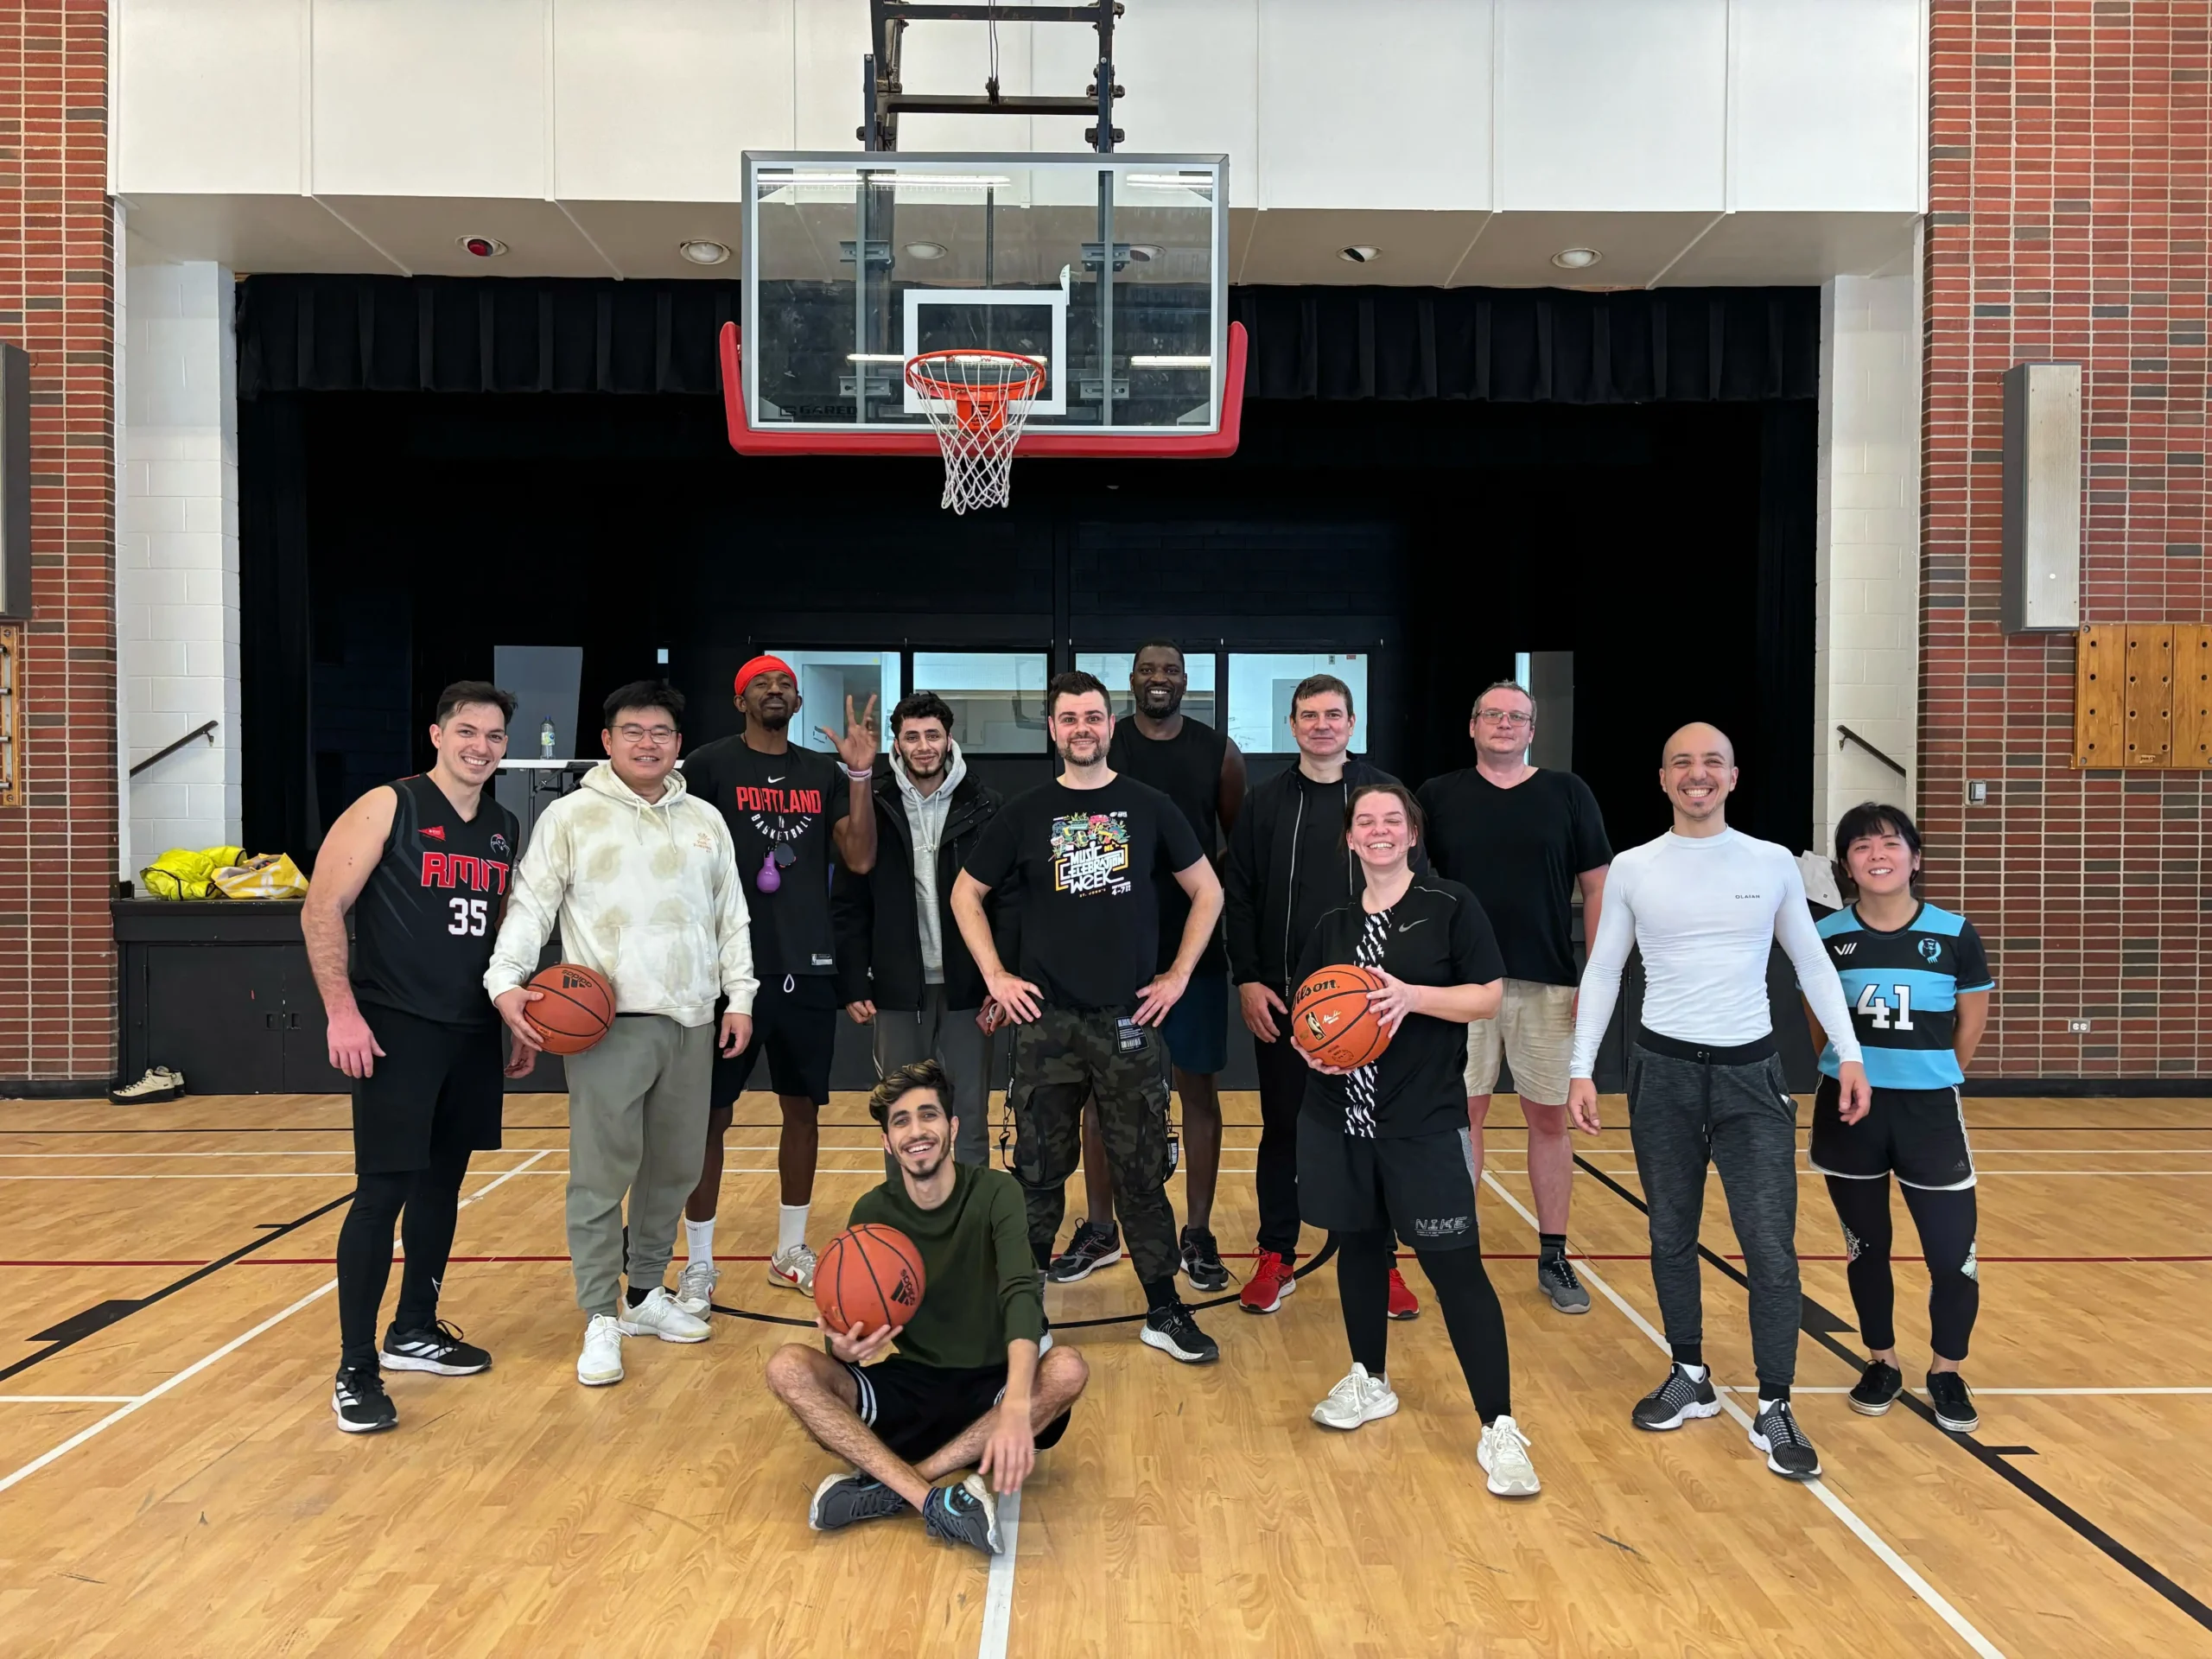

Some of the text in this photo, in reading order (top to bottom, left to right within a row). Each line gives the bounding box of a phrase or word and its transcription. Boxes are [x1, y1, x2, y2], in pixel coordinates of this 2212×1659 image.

[736, 786, 822, 814] PORTLAND
[421, 851, 510, 895] RMIT
[1059, 849, 1125, 881] CELEBRATION
[448, 897, 488, 937] 35
[562, 969, 593, 988] adidas
[1856, 983, 1914, 1031] 41
[1415, 1216, 1468, 1230] NIKE
